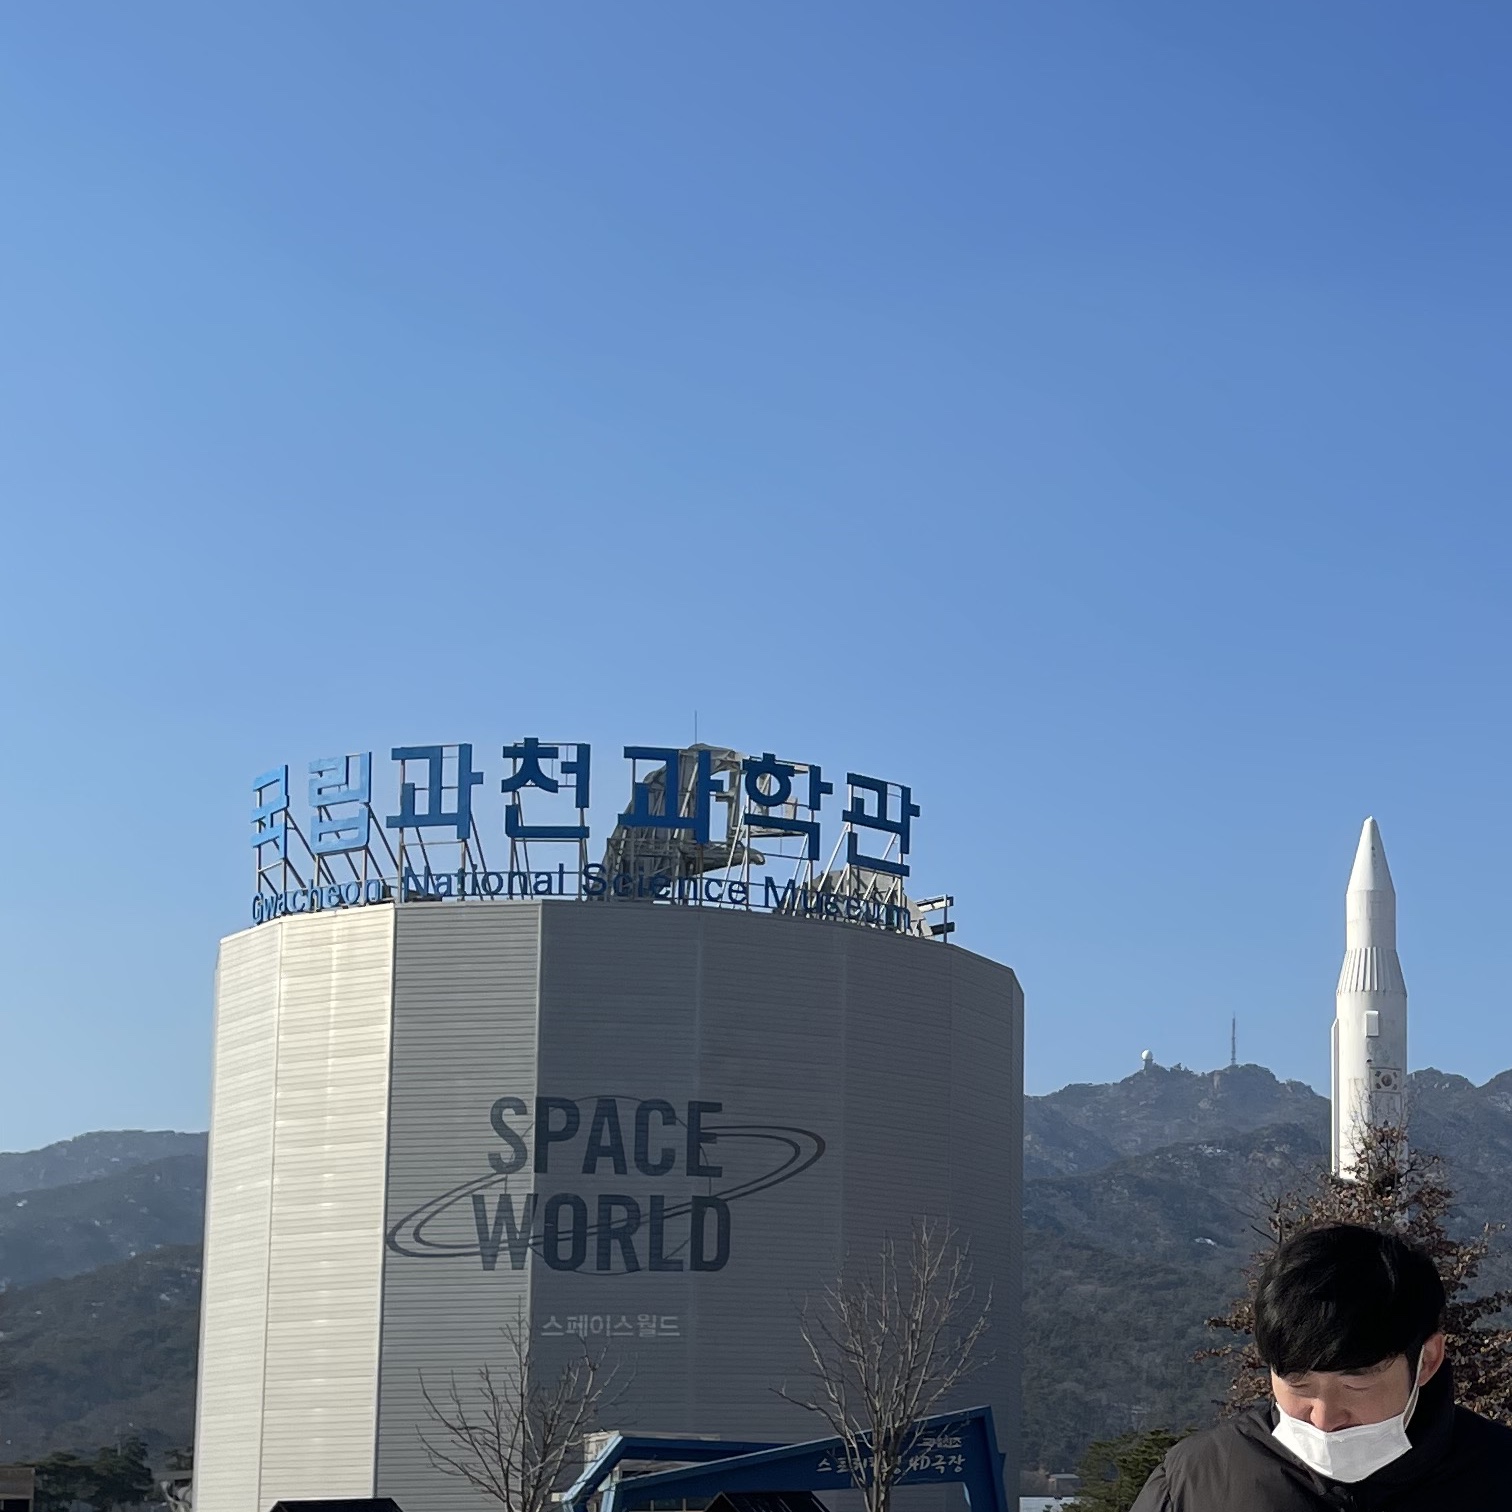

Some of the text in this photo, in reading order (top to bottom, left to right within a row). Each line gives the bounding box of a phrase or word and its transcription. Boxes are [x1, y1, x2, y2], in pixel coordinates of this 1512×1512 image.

[252, 862, 911, 934] Gwacheon National Science Museum
[487, 1096, 723, 1178] SPACE
[472, 1192, 731, 1273] WORLD
[540, 1313, 681, 1338] 스페이스월드
